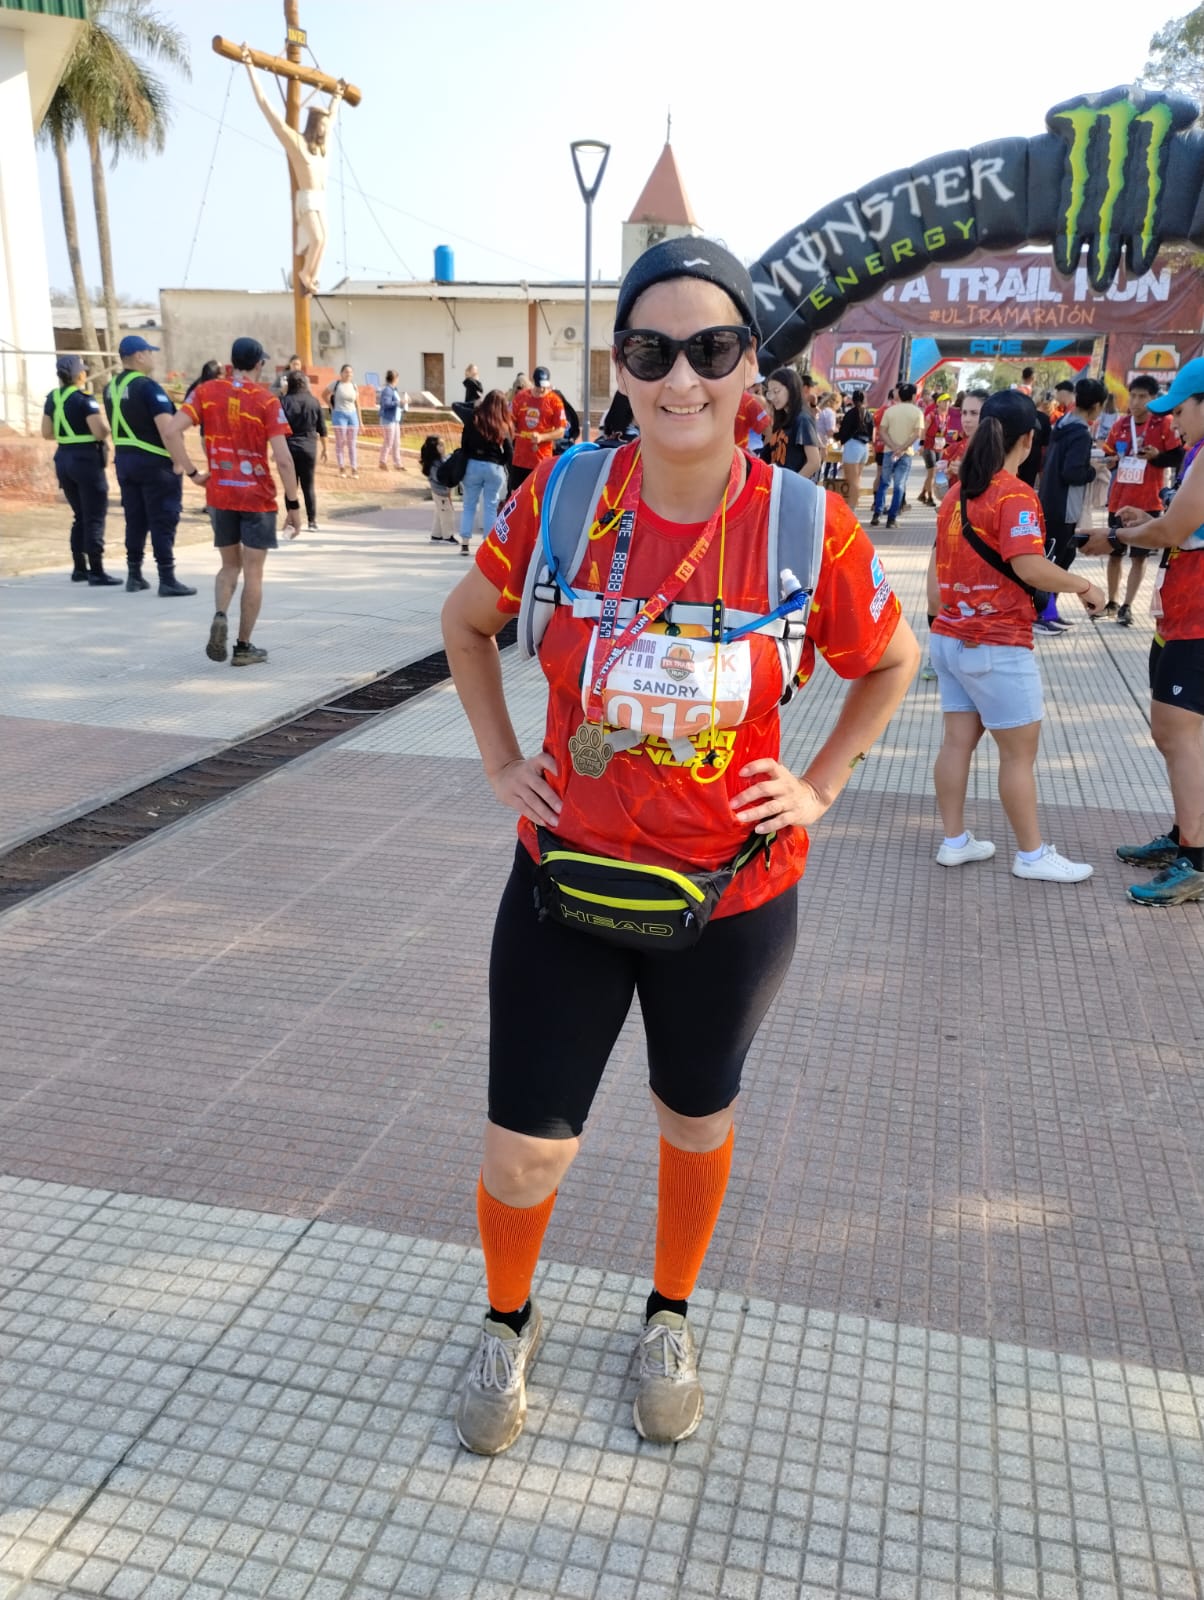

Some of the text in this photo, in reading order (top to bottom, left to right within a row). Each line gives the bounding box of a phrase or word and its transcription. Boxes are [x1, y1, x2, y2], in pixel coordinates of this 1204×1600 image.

[752, 157, 1016, 311] MONSTER
[809, 217, 976, 310] ENERGY
[941, 267, 1063, 303] TRAIL
[929, 303, 1096, 325] #ULTRAMARATÓN
[1119, 468, 1141, 481] 260
[618, 511, 635, 538] TIME
[607, 552, 627, 592] 88:88
[602, 600, 617, 617] 88
[630, 615, 650, 635] RUN
[633, 679, 700, 698] SANDRY
[560, 903, 674, 937] HEAD
